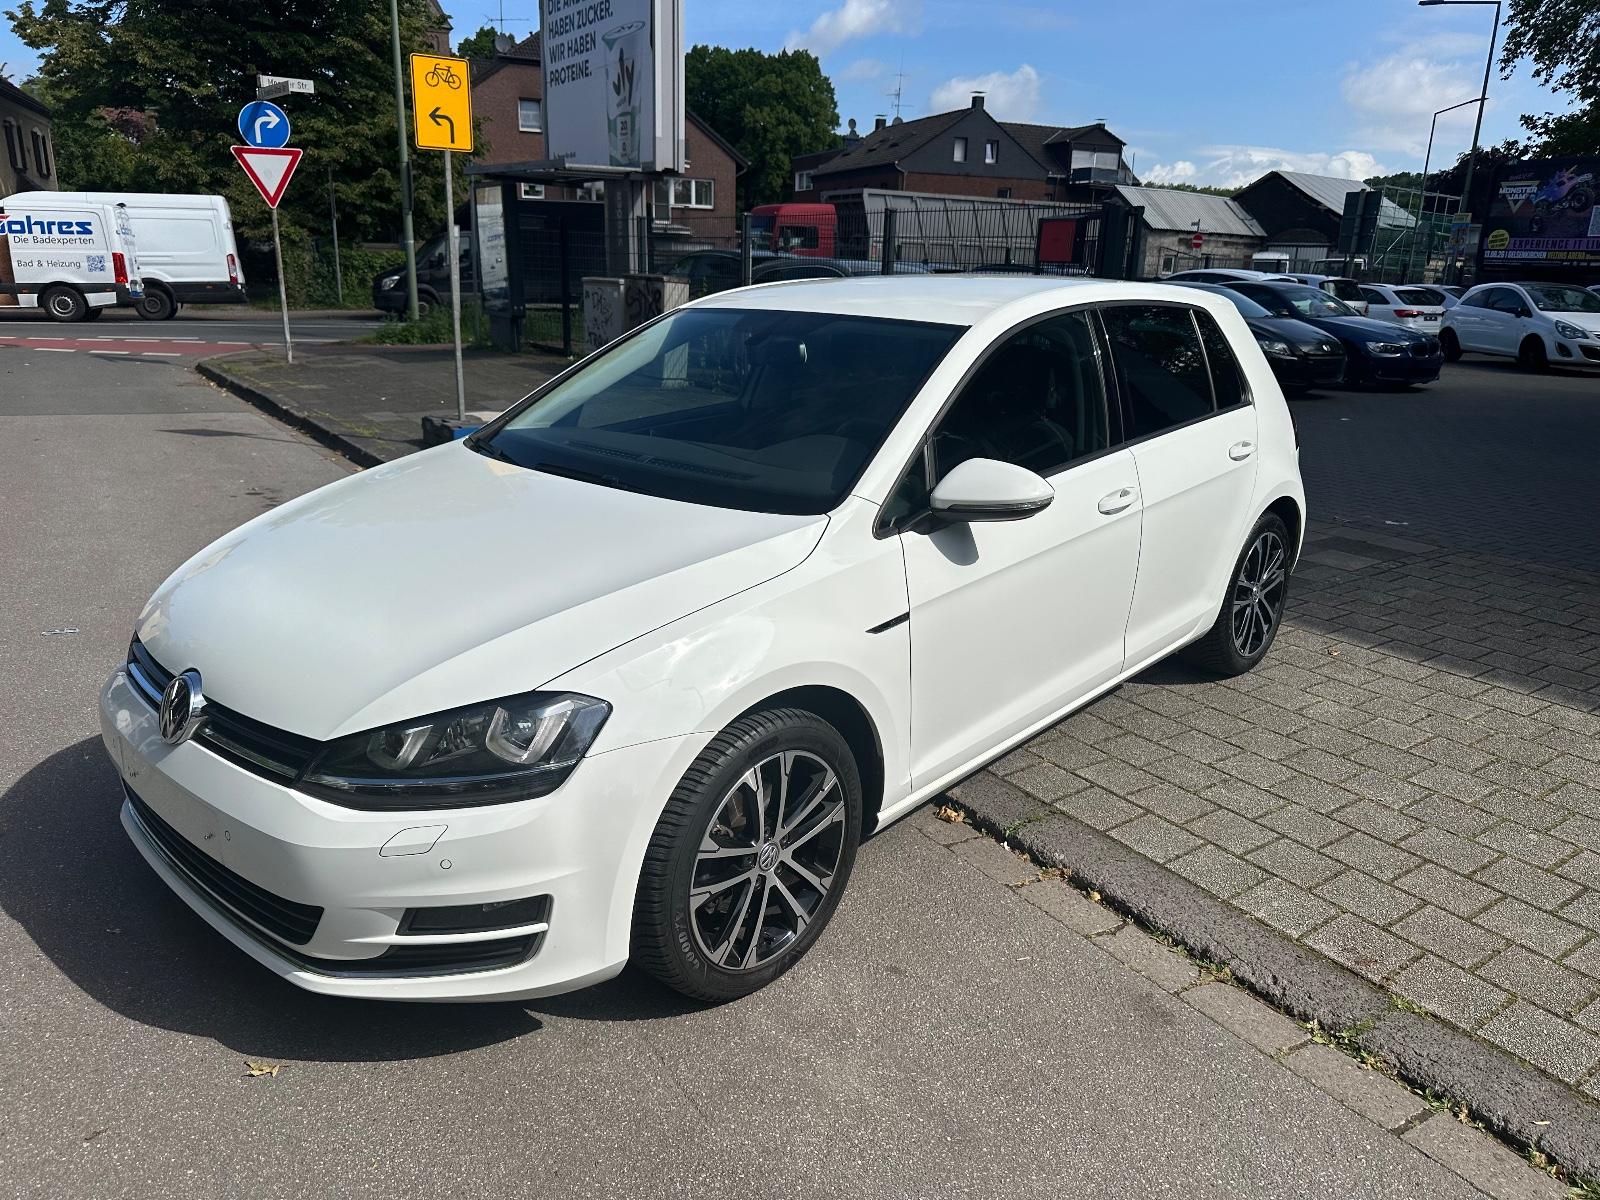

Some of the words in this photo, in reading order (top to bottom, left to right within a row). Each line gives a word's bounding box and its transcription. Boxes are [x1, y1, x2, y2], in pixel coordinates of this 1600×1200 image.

[548, 0, 561, 16] DIE
[549, 13, 575, 41] HABEN
[577, 0, 613, 30] ZUCKER.
[549, 43, 565, 64] WIR
[567, 30, 596, 58] HABEN
[550, 59, 592, 88] PROTEINE.
[13, 235, 29, 244] Die
[32, 235, 95, 246] Badexperten
[1513, 239, 1570, 249] EXPERIENCE
[17, 259, 33, 267] Bad
[46, 260, 81, 269] Heizung
